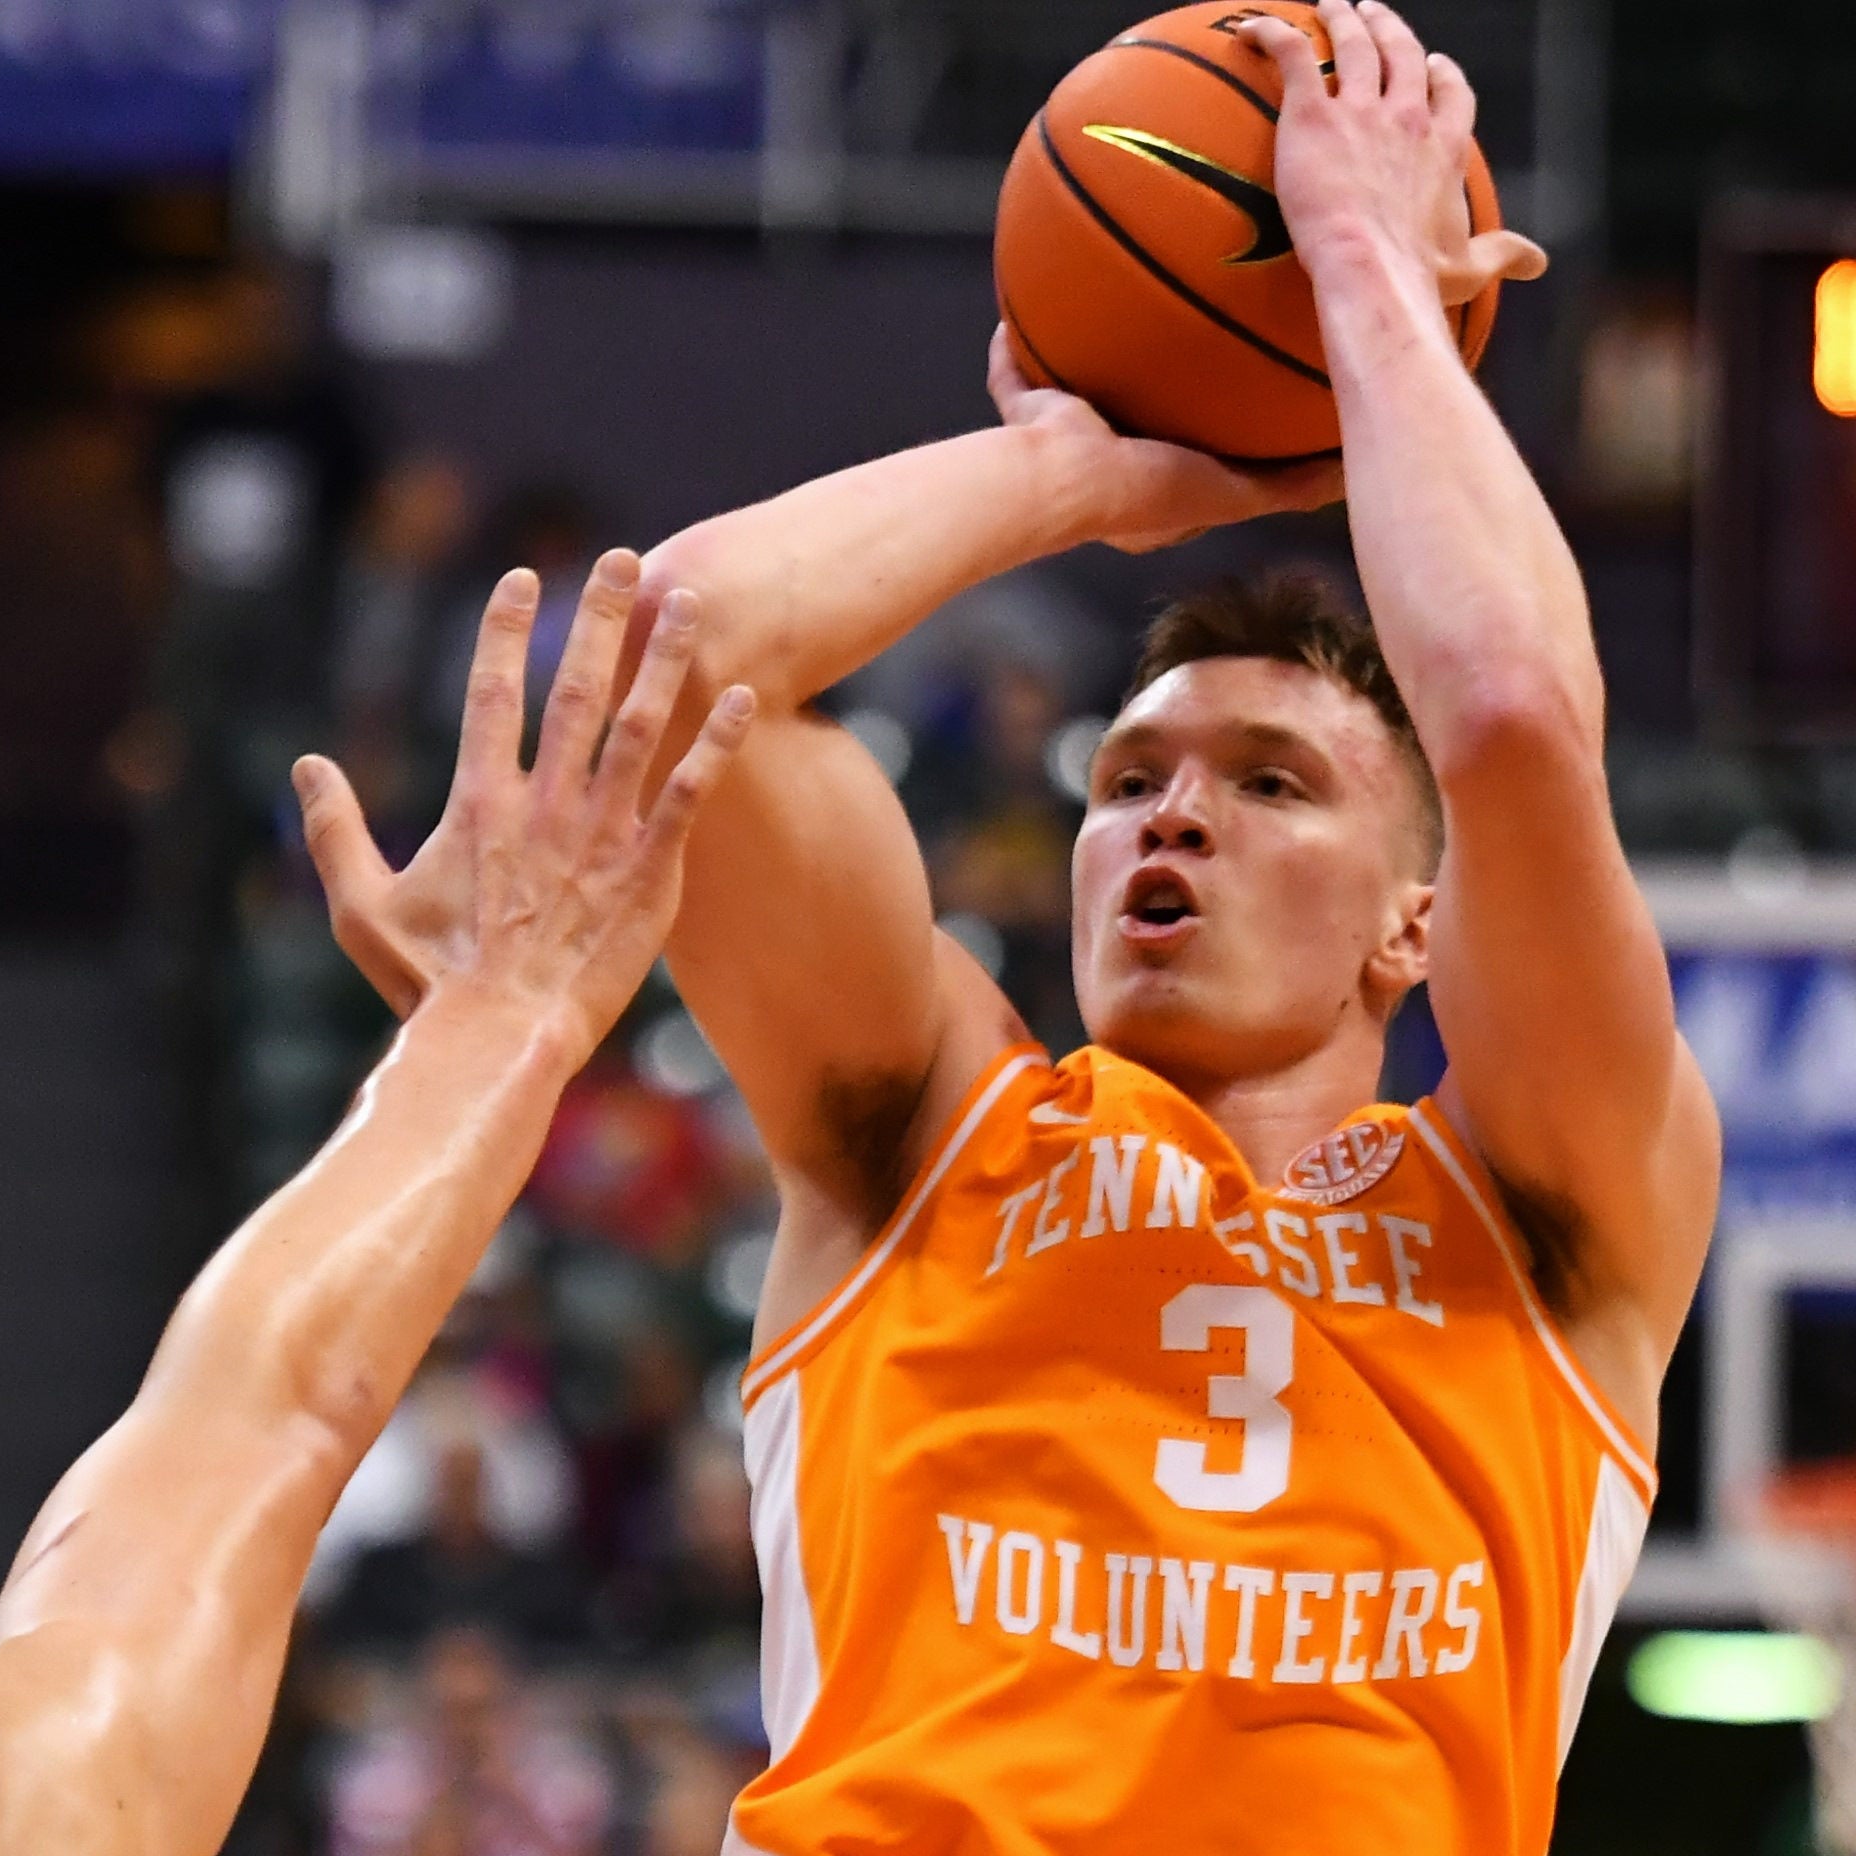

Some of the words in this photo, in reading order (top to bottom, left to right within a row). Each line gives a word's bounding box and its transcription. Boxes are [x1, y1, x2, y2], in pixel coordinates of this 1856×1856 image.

[984, 1135, 1446, 1328] TENNSSEE
[1296, 1122, 1381, 1190] SEC
[1152, 1284, 1294, 1512] 3
[936, 1512, 1486, 1685] VOLUNTEERS
